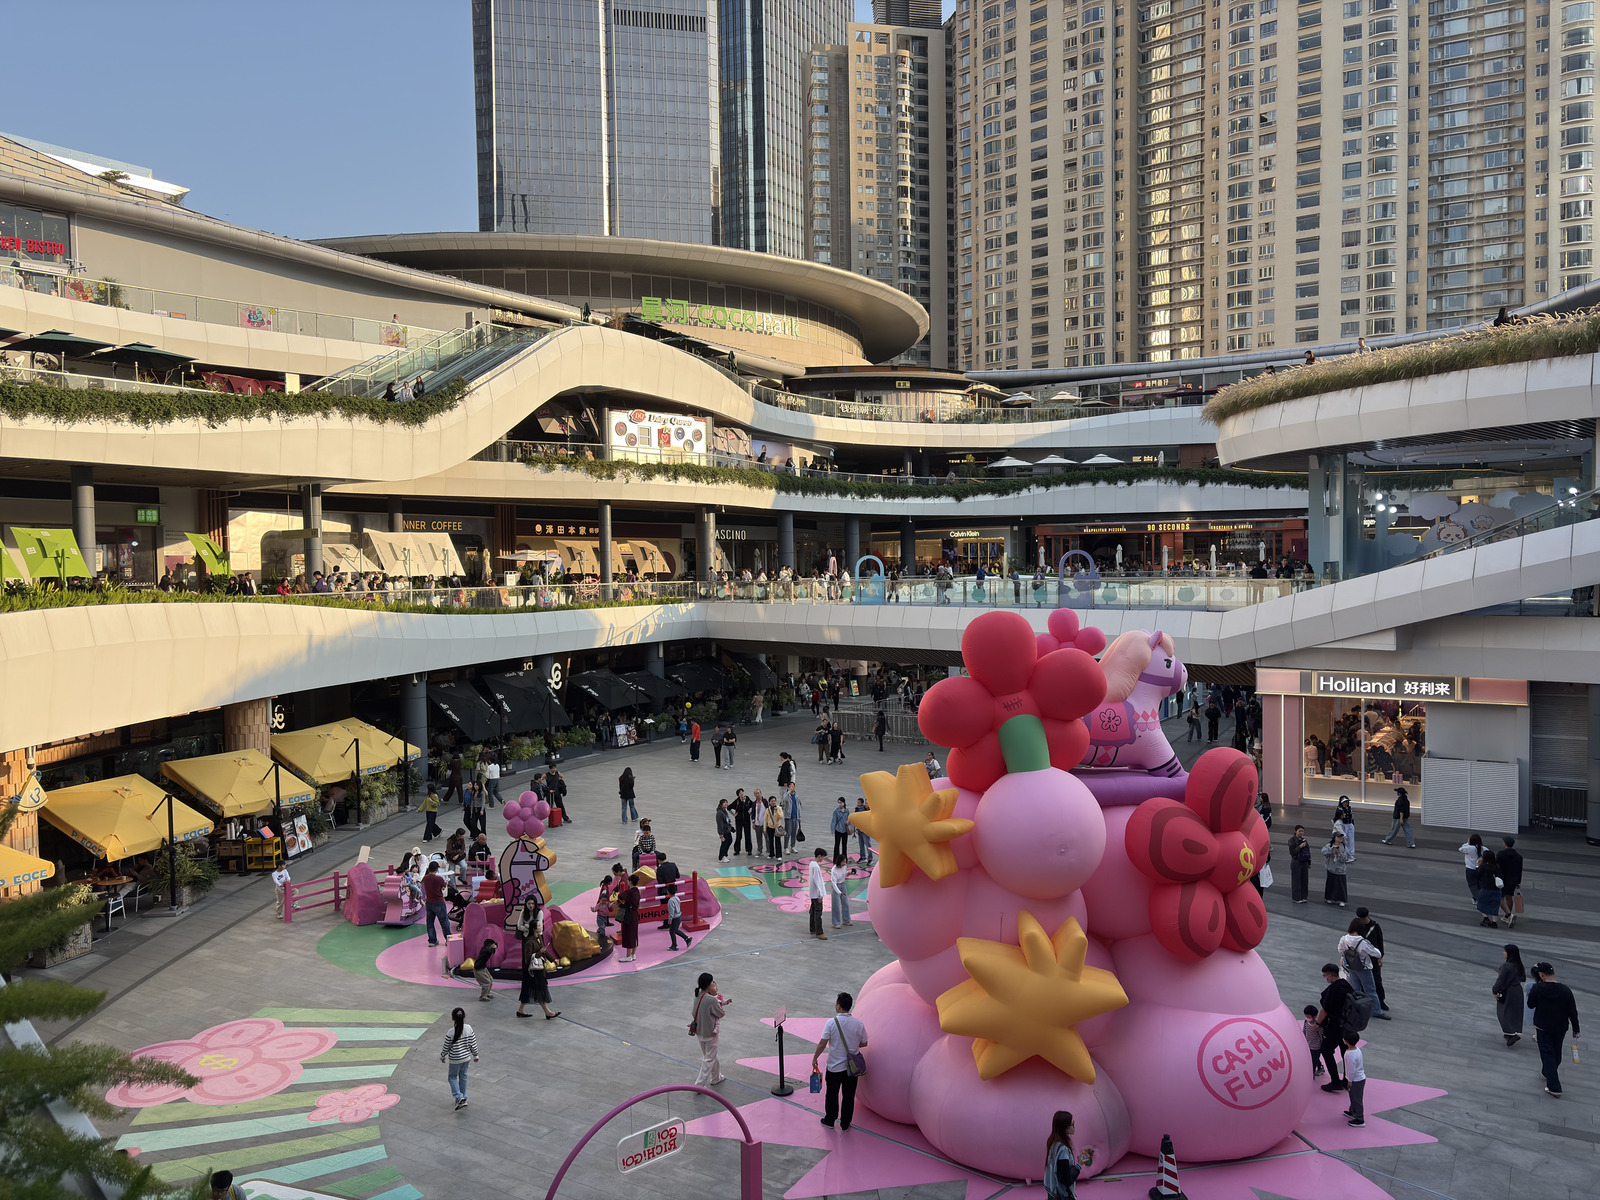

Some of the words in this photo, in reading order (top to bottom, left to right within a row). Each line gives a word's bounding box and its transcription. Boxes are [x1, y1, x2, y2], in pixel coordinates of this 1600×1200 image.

[27, 239, 65, 255] BISTRO
[641, 296, 689, 324] 星河
[699, 305, 757, 330] COCO
[763, 313, 801, 337] Park
[635, 412, 645, 421] DQ
[431, 520, 463, 531] COFFEE
[1147, 523, 1156, 531] 90
[1158, 523, 1190, 531] SECONDS
[715, 529, 746, 540] ASCINO
[1319, 676, 1396, 694] Holiland
[1403, 681, 1451, 696] 好利来
[638, 909, 669, 920] ICHFLO
[1212, 1029, 1270, 1075] CASH
[1223, 1050, 1286, 1102] FLOW
